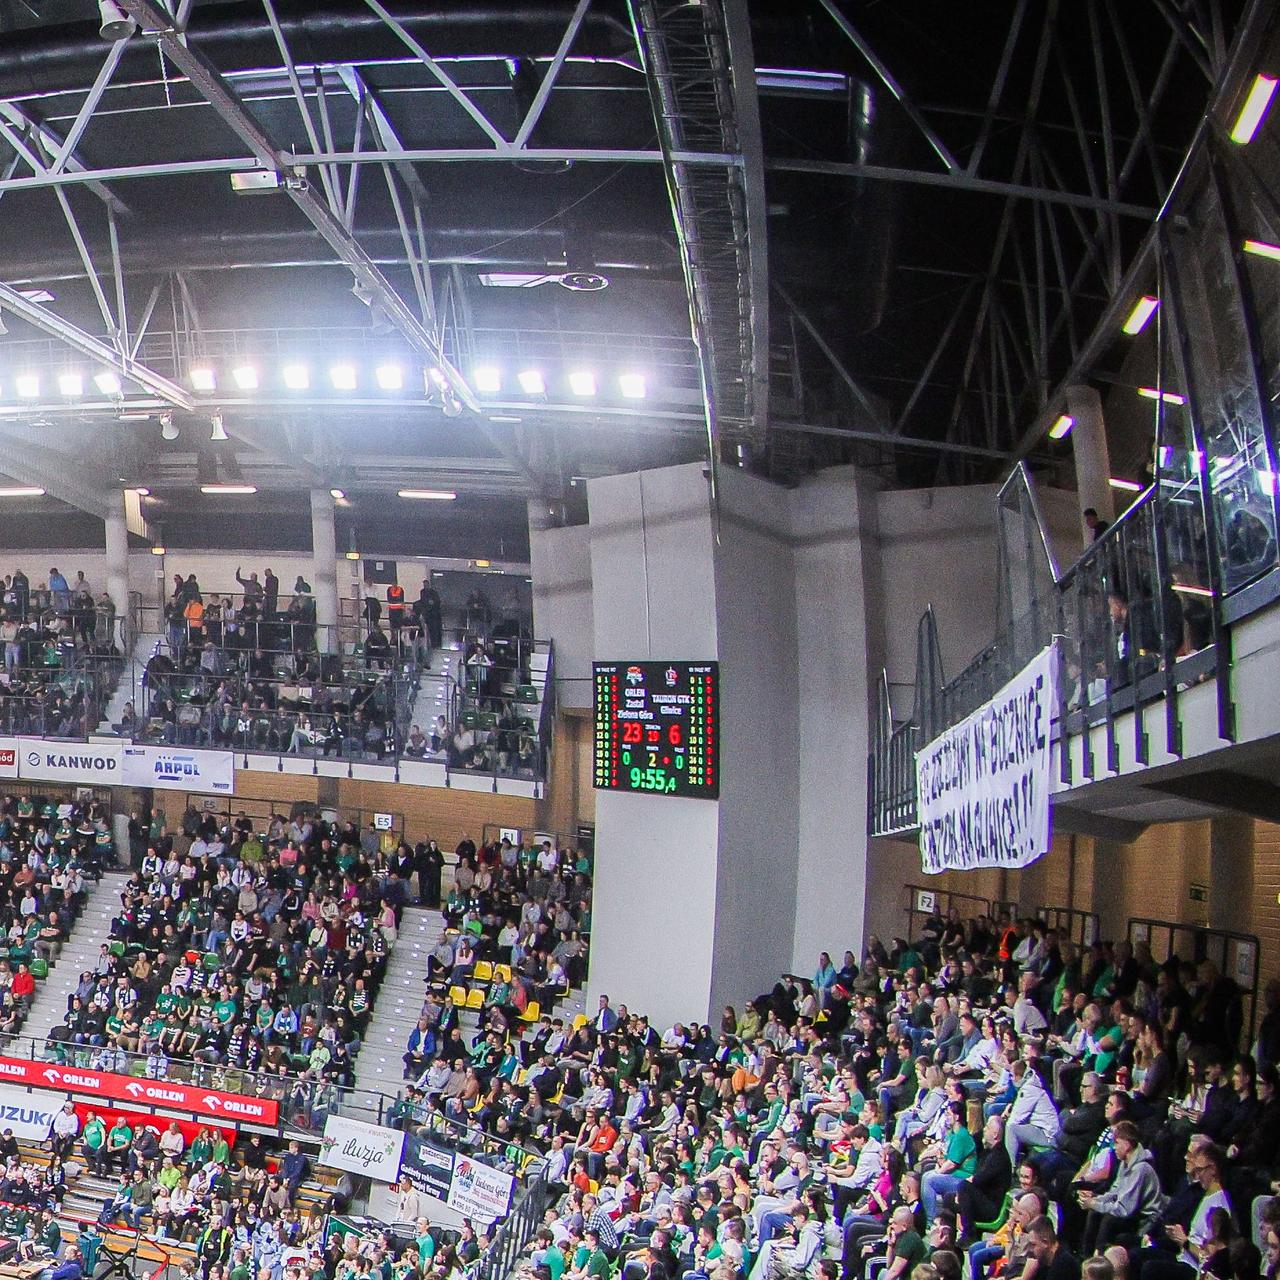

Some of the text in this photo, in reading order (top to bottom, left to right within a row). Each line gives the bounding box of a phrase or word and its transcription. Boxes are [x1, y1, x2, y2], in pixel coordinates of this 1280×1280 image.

[624, 689, 646, 697] ORLEN
[623, 722, 643, 743] 23
[668, 724, 682, 745] 6
[46, 754, 117, 770] KANWOD
[622, 751, 630, 765] 0
[648, 752, 657, 767] 2
[674, 755, 684, 769] 0
[154, 761, 200, 776] ARPOL
[377, 817, 390, 826] E5
[920, 896, 933, 908] F2
[62, 1073, 100, 1089] ORLEN
[146, 1087, 185, 1102] ORLEN
[223, 1100, 263, 1116] ORLEN
[341, 1137, 385, 1168] iluzja
